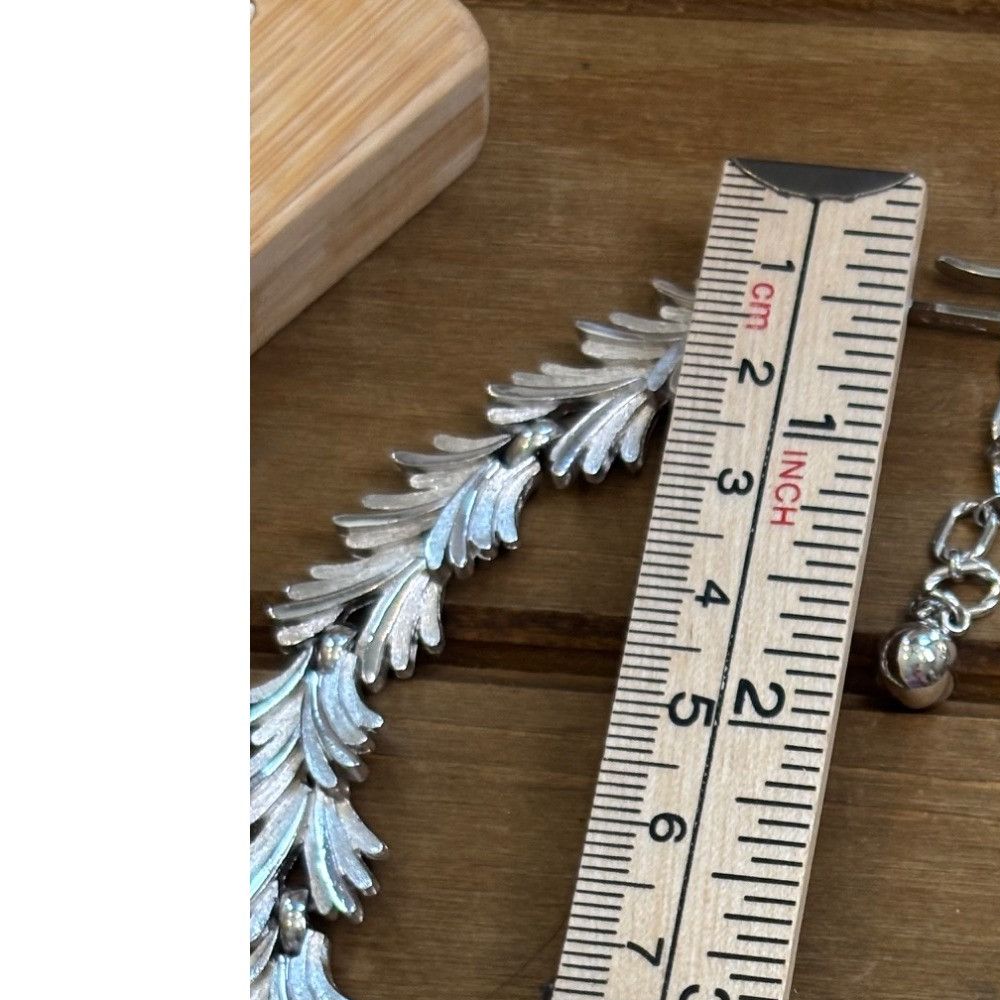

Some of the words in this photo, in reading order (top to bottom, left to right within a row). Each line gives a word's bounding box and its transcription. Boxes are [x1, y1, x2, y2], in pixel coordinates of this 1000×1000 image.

[761, 260, 795, 273] 1
[746, 282, 775, 330] cm
[738, 358, 774, 387] 2
[788, 414, 836, 430] 1
[717, 468, 754, 496] 3
[770, 450, 808, 527] INCH
[695, 579, 730, 608] 4
[668, 692, 716, 727] 5
[733, 678, 786, 718] 2
[649, 812, 687, 843] 6
[626, 937, 664, 966] 7
